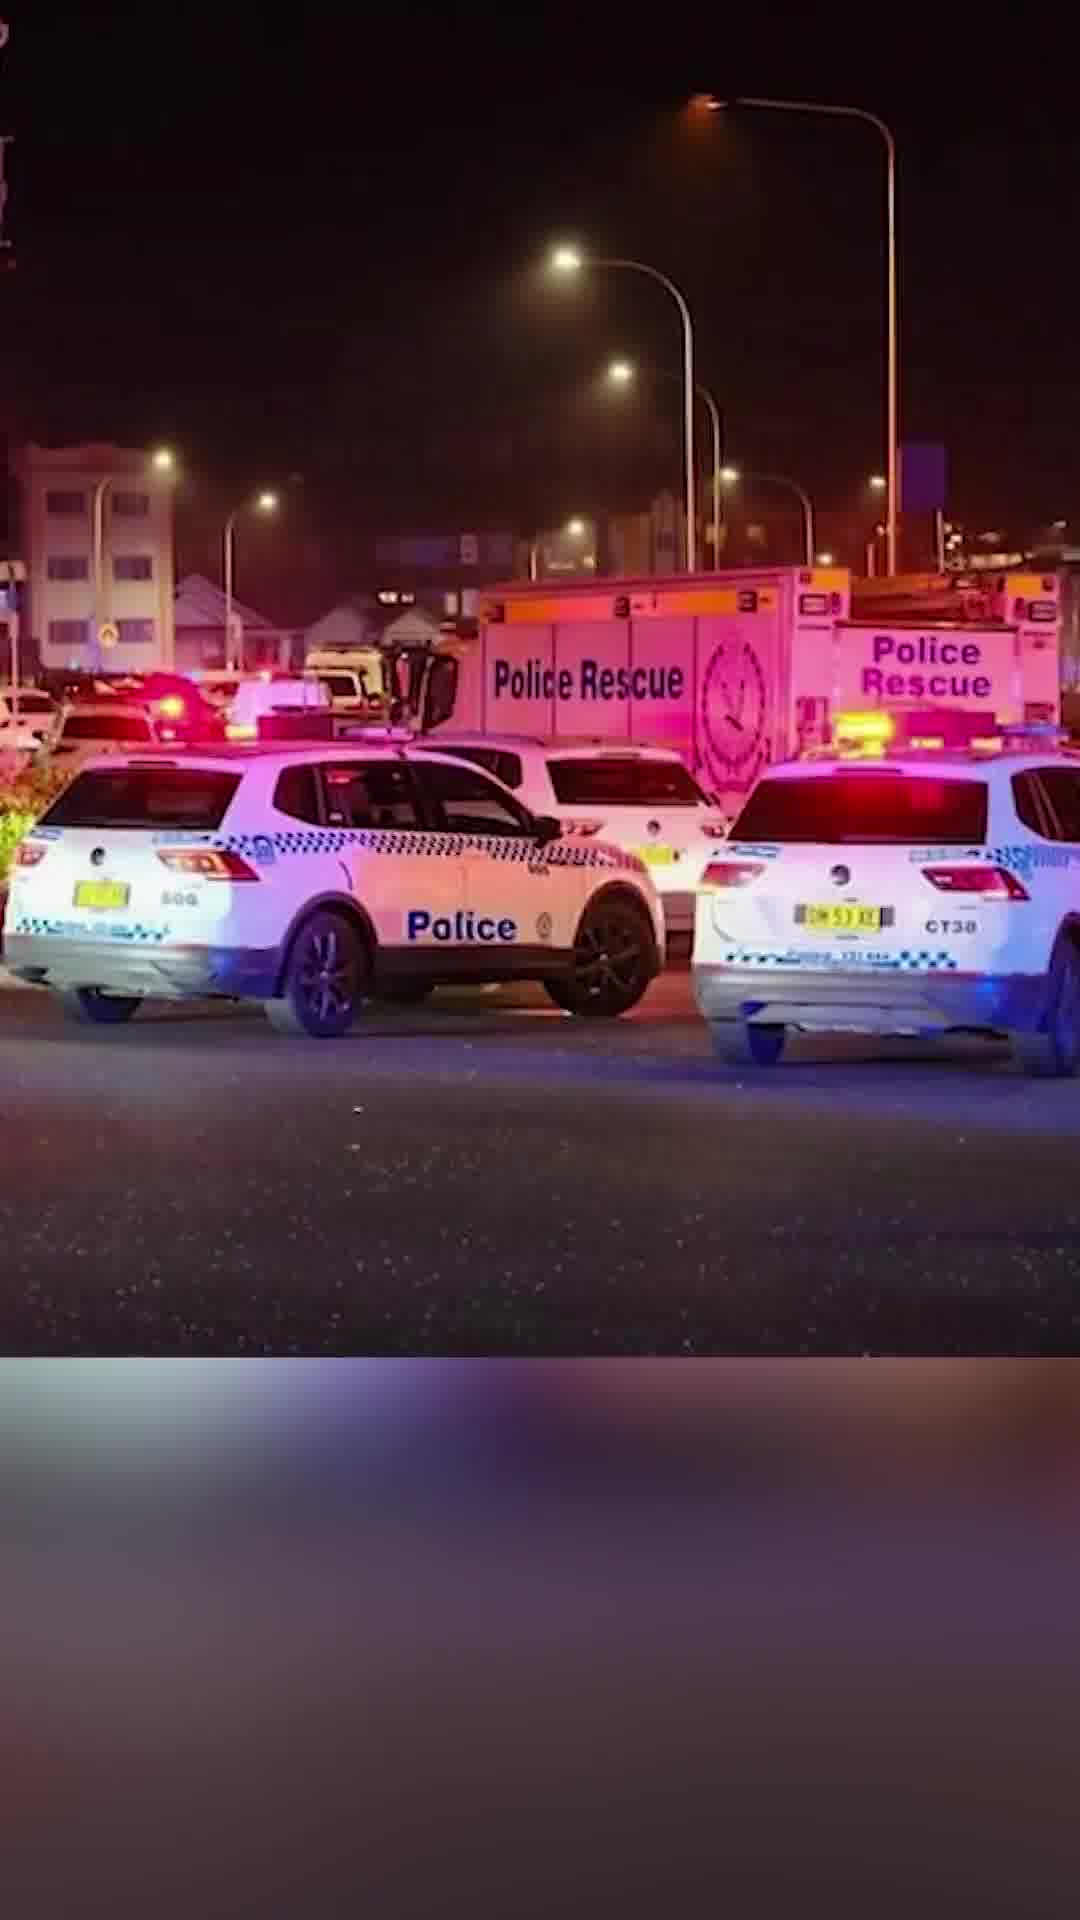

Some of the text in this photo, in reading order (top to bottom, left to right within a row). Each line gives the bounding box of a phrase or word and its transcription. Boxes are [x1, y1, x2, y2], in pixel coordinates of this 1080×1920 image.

[873, 637, 980, 664] Police
[494, 659, 684, 700] Police Rescue
[862, 668, 991, 697] Rescue
[408, 910, 517, 941] Police
